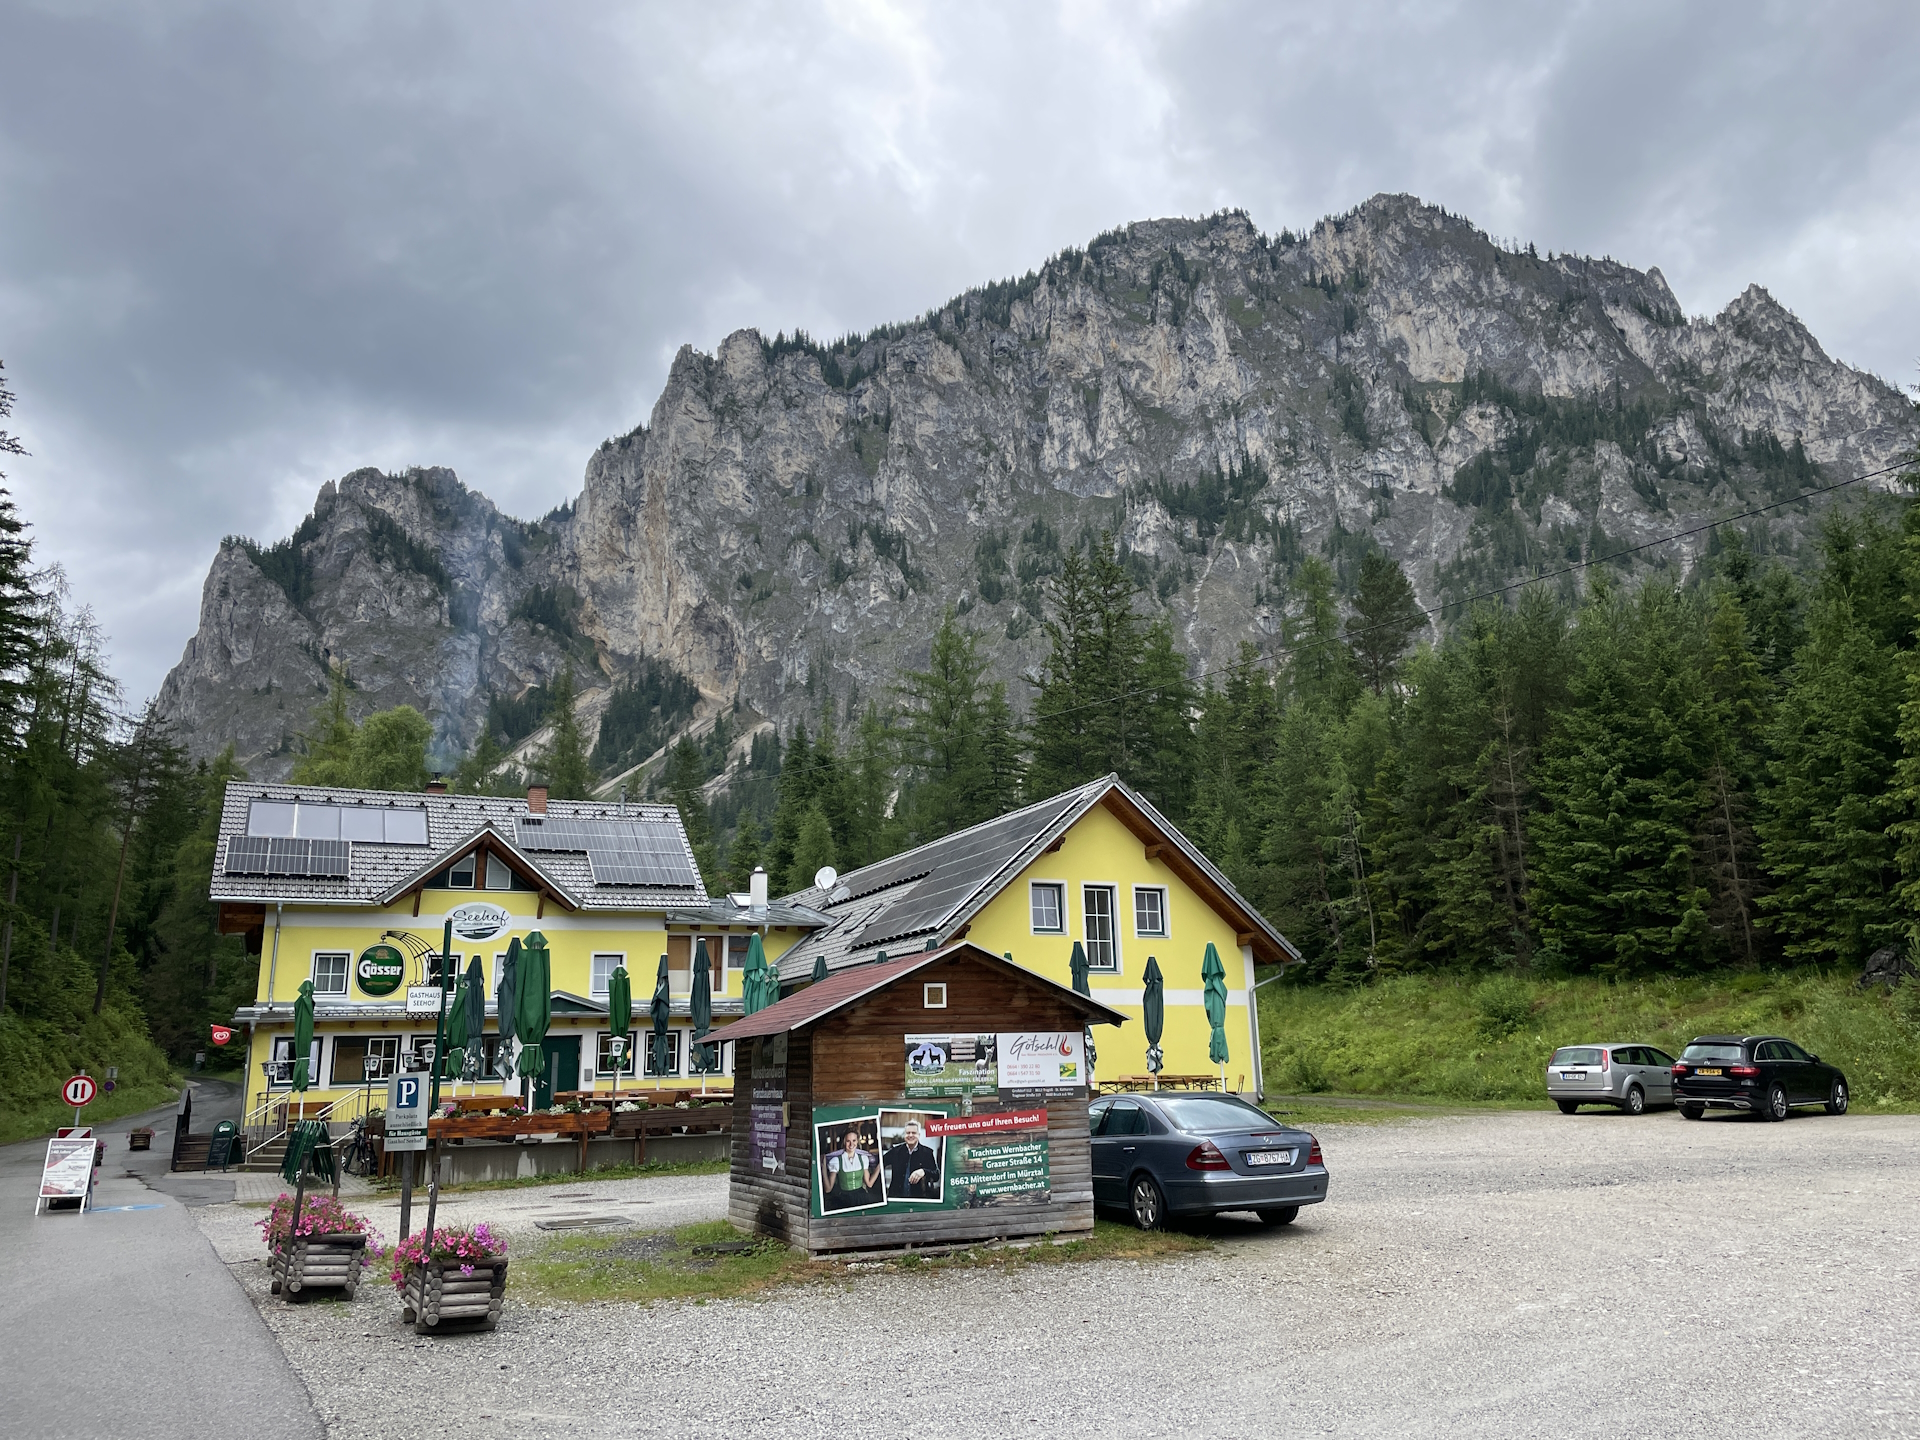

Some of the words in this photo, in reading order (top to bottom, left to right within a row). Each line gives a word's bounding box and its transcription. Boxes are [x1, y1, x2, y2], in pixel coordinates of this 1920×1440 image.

[453, 910, 509, 927] Seehof
[359, 960, 402, 979] Gösser
[1010, 1034, 1060, 1061] Götschl
[399, 1081, 416, 1106] P
[930, 1123, 943, 1132] Wir
[944, 1122, 967, 1131] freuen
[968, 1121, 981, 1129] uns
[982, 1119, 993, 1127] auf
[995, 1117, 1013, 1126] Ihren
[1014, 1114, 1039, 1124] Besuch!
[971, 1147, 1001, 1157] Trachten
[1001, 1143, 1042, 1154] Wernbacher
[1252, 1154, 1261, 1163] ZG
[985, 1160, 1008, 1169] Grazer
[1009, 1157, 1032, 1167] Straße
[1033, 1155, 1043, 1163] 14
[950, 1177, 969, 1186] 8662
[970, 1172, 1006, 1183] Mitterdorf
[1007, 1170, 1016, 1179] im
[1017, 1168, 1044, 1178] Mürztal
[979, 1181, 1045, 1195] www.wernbacher.at
